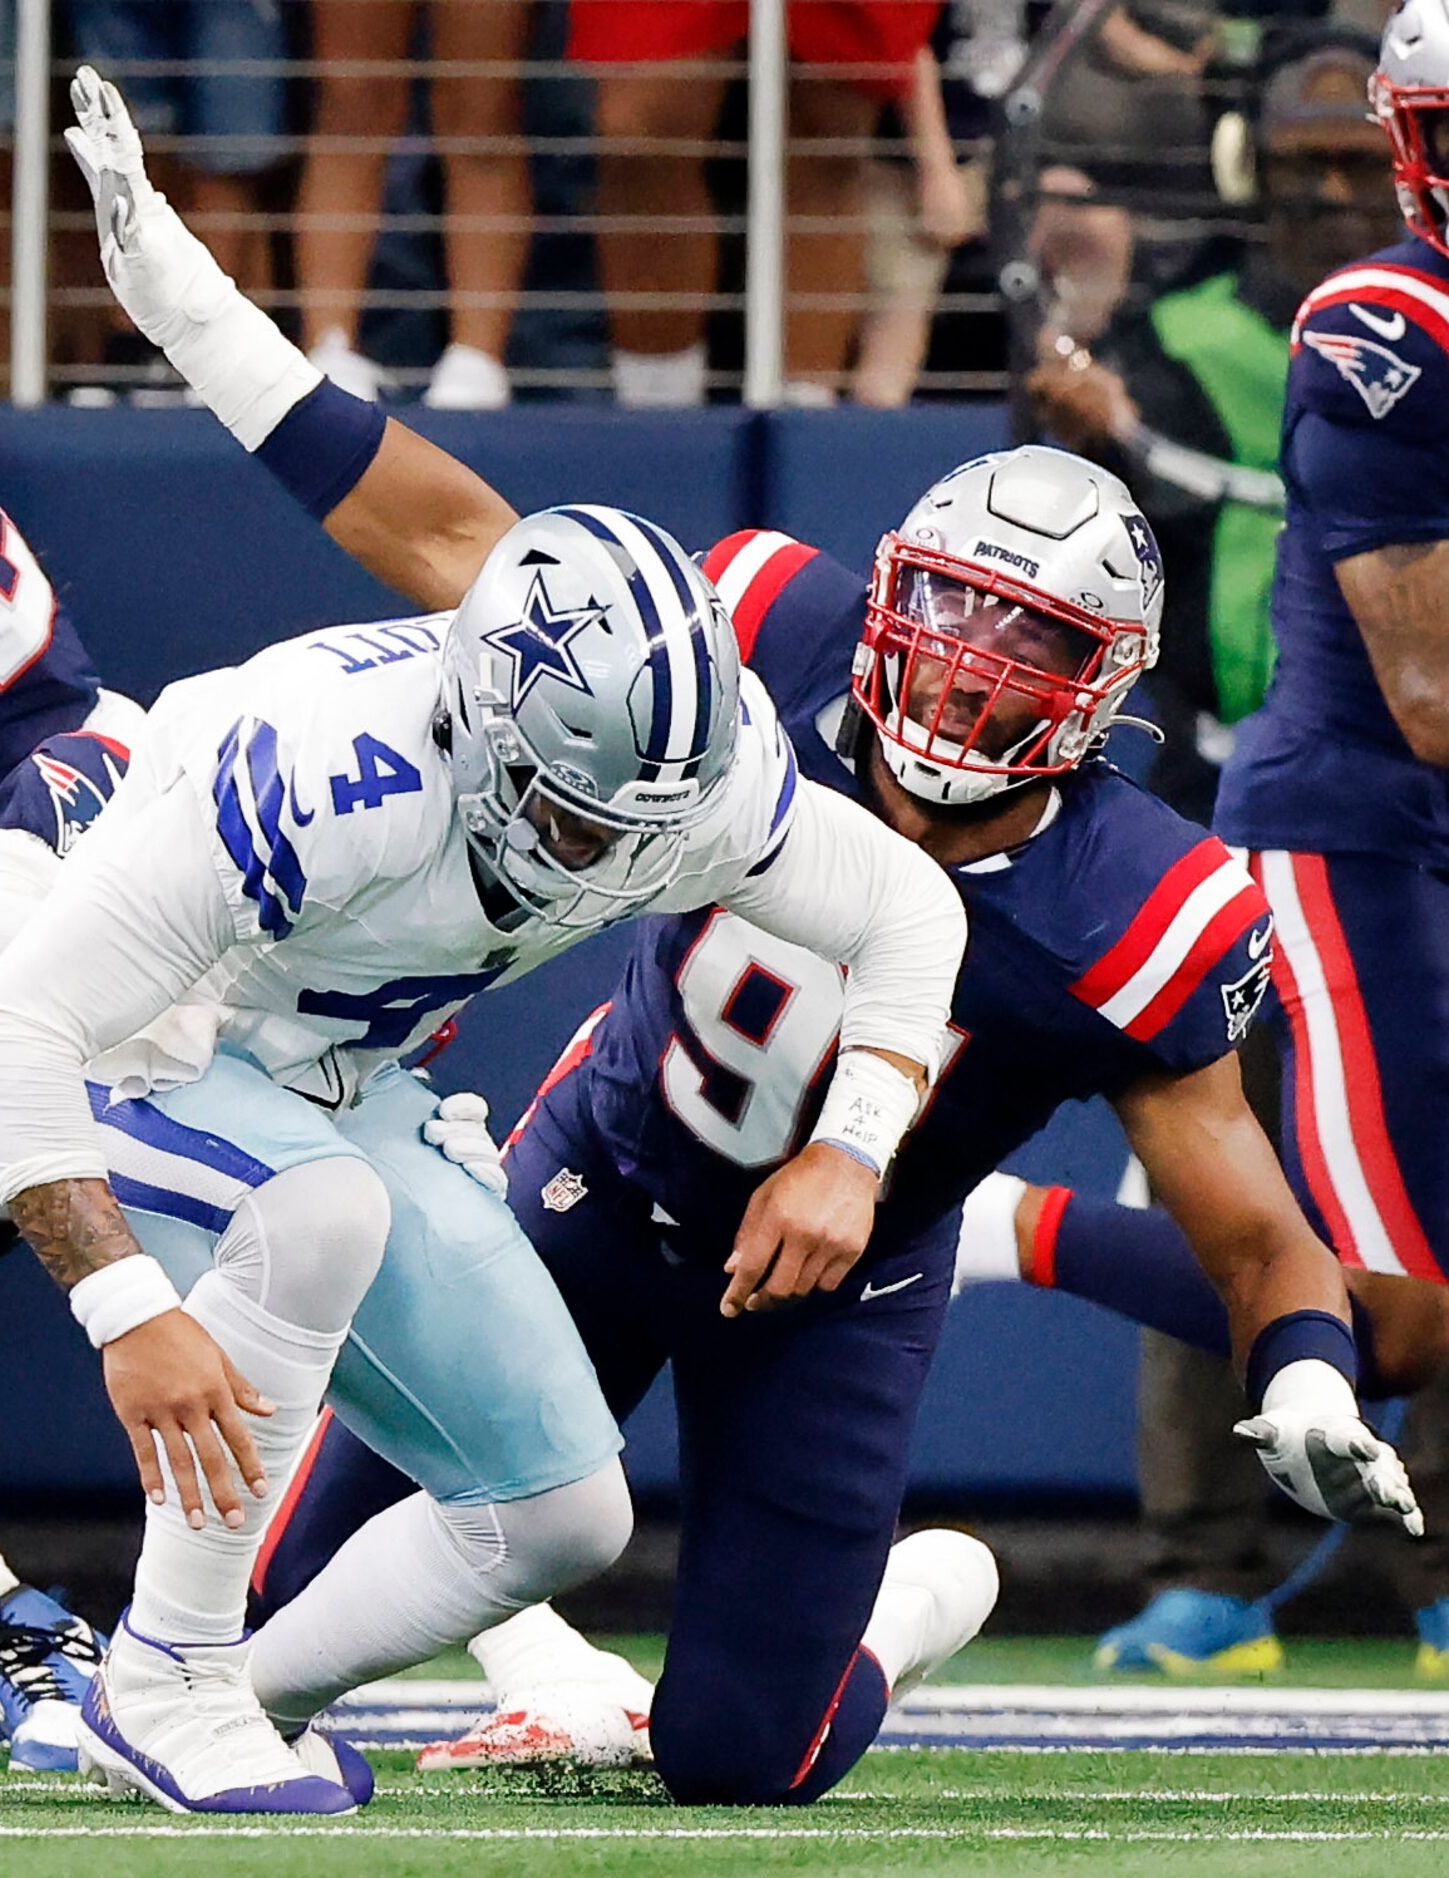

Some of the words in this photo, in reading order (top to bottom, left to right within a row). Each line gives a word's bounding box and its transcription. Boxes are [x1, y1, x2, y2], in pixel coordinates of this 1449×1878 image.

[973, 540, 1040, 579] PATRIOTS
[328, 731, 423, 816] 4
[297, 957, 519, 1050] 4
